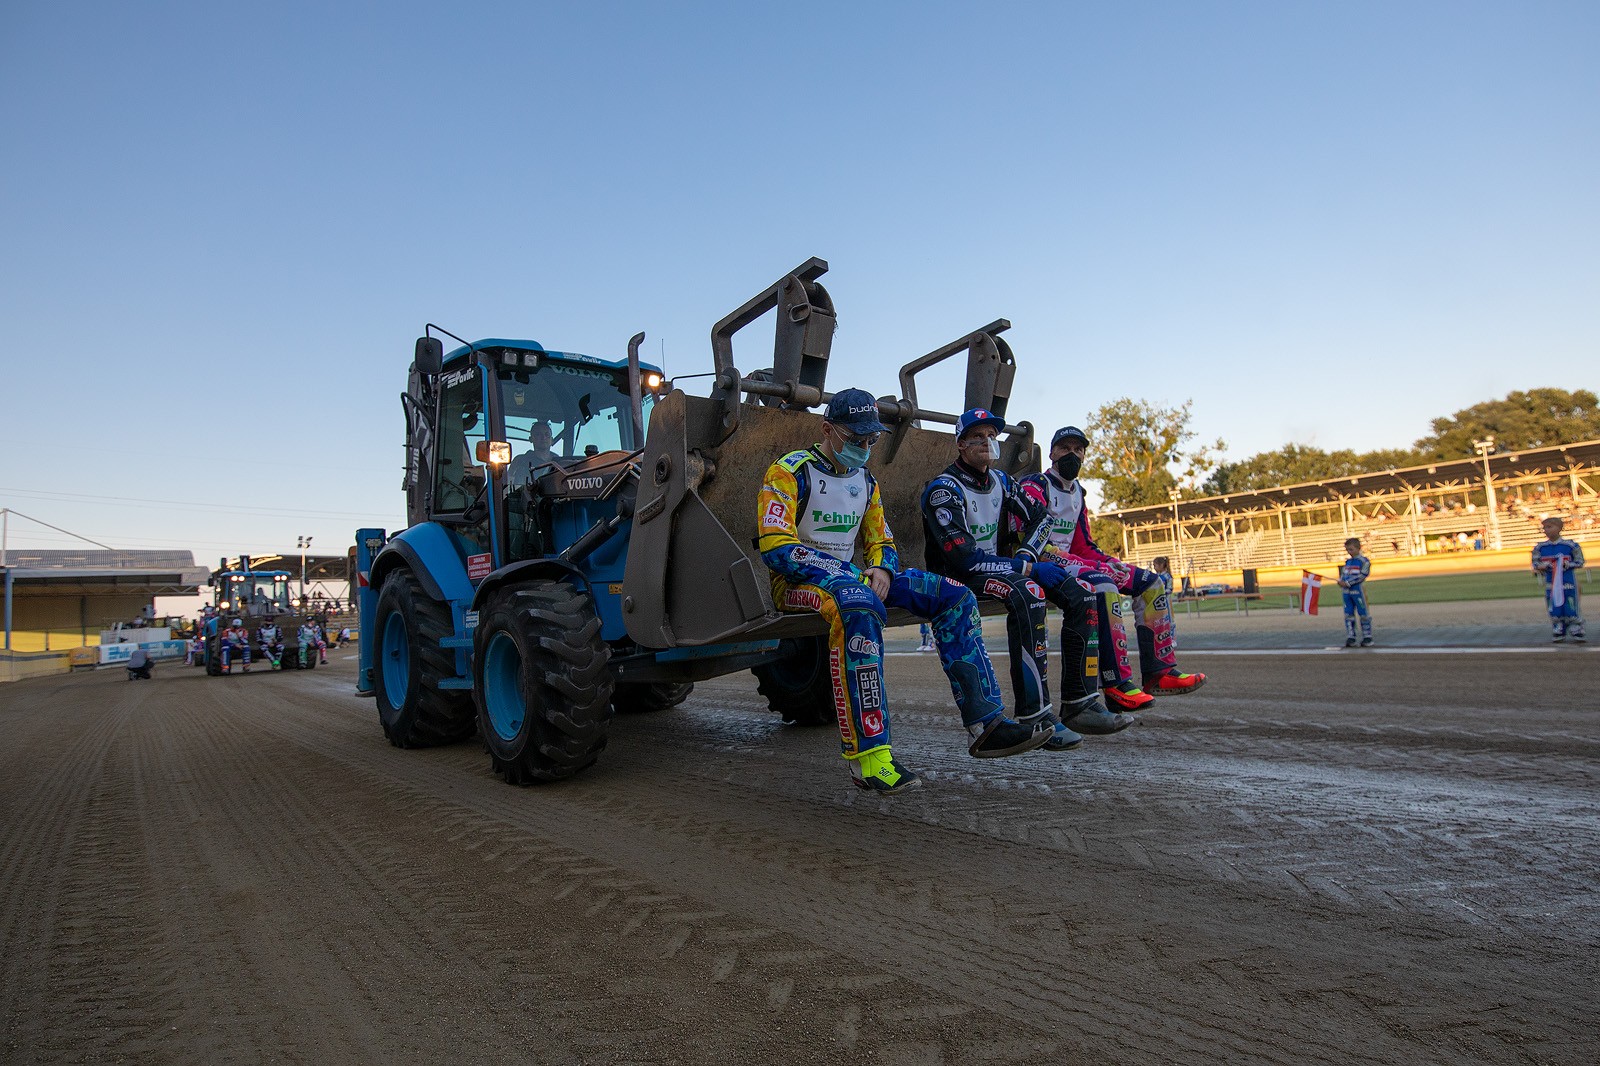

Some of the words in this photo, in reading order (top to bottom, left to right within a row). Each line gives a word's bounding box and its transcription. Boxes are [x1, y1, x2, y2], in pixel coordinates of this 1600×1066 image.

[551, 364, 614, 382] VOLVO
[567, 476, 603, 490] VOLVO
[819, 480, 827, 494] 2
[971, 500, 978, 513] 3
[1054, 496, 1058, 508] 1
[763, 517, 788, 528] IGANT
[860, 672, 872, 709] INTER
[869, 670, 880, 708] CARS
